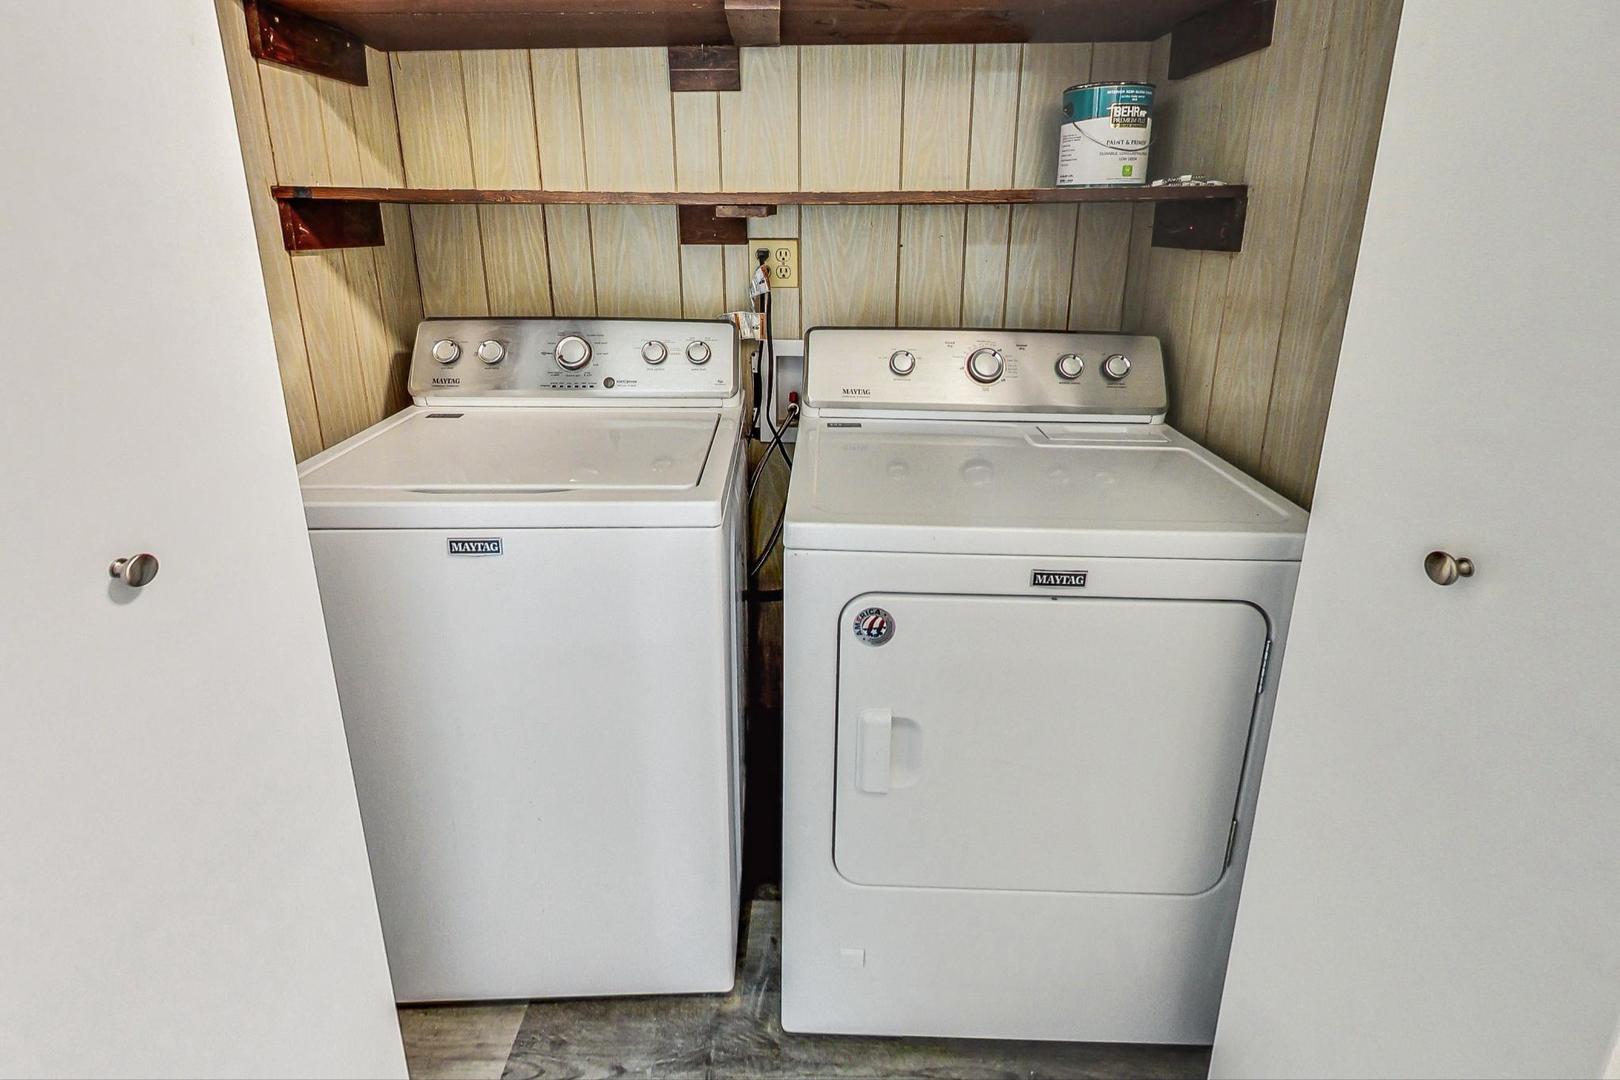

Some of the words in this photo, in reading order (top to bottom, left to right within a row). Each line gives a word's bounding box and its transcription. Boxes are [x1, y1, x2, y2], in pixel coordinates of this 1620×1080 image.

[1112, 106, 1140, 117] BEHR
[842, 388, 871, 396] MAYTAG
[450, 542, 499, 552] MAYTAG
[1035, 574, 1085, 585] MAYTAG
